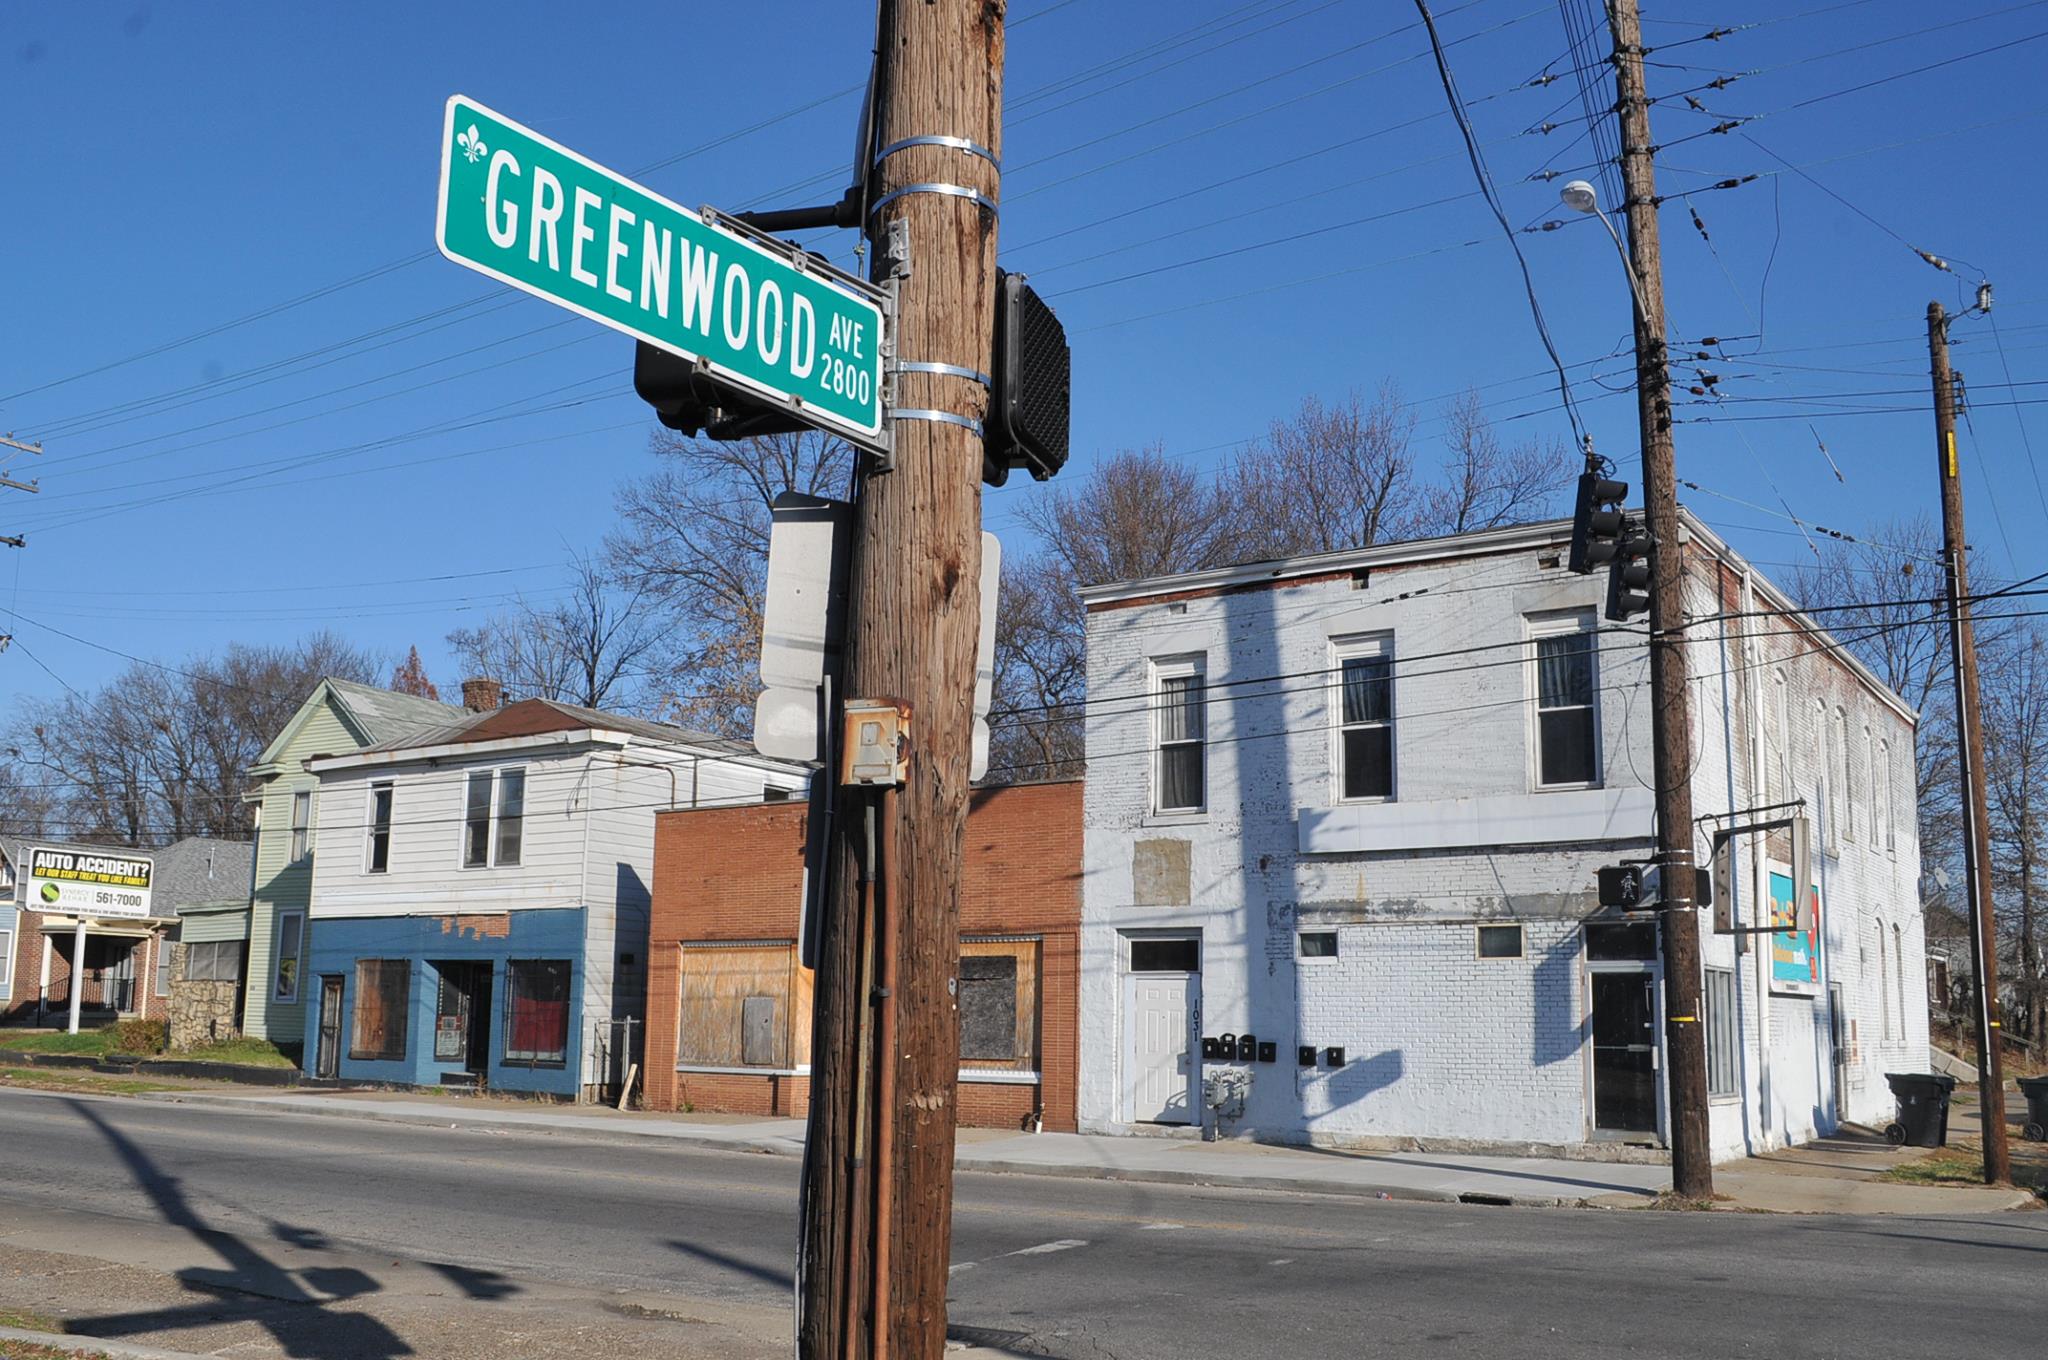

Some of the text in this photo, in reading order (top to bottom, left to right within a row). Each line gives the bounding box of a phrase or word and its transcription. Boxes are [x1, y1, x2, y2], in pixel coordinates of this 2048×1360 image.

[485, 149, 864, 379] GREENWOOD AVE
[820, 352, 870, 407] 2800
[35, 867, 46, 876] LET
[60, 869, 78, 879] STAFF
[79, 871, 97, 881] TREAT
[97, 873, 110, 883] YOU
[110, 875, 123, 884] LIKE
[36, 852, 149, 877] AUTO ACCIDENT?
[96, 892, 142, 907] 561-7000
[1192, 999, 1200, 1042] 1031
